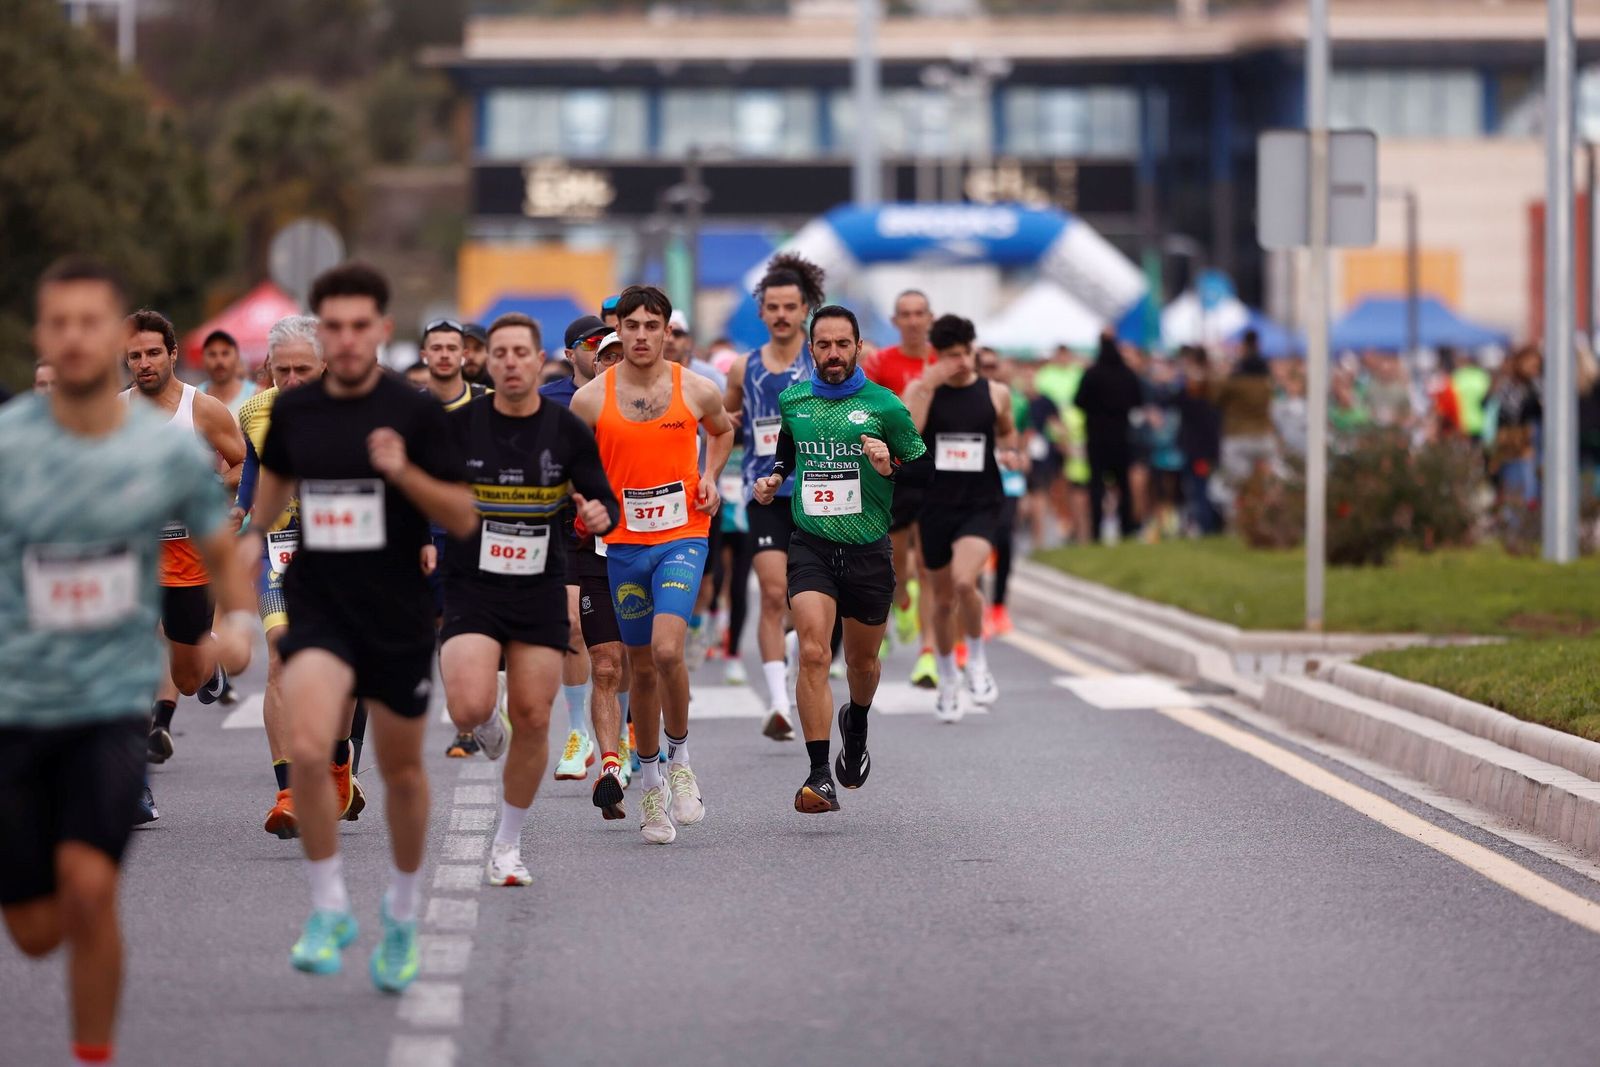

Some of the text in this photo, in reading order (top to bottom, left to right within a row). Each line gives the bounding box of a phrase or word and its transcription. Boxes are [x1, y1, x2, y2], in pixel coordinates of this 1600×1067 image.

[797, 437, 863, 460] mijas
[814, 490, 835, 502] 23
[634, 505, 665, 519] 377
[490, 544, 527, 560] 802
